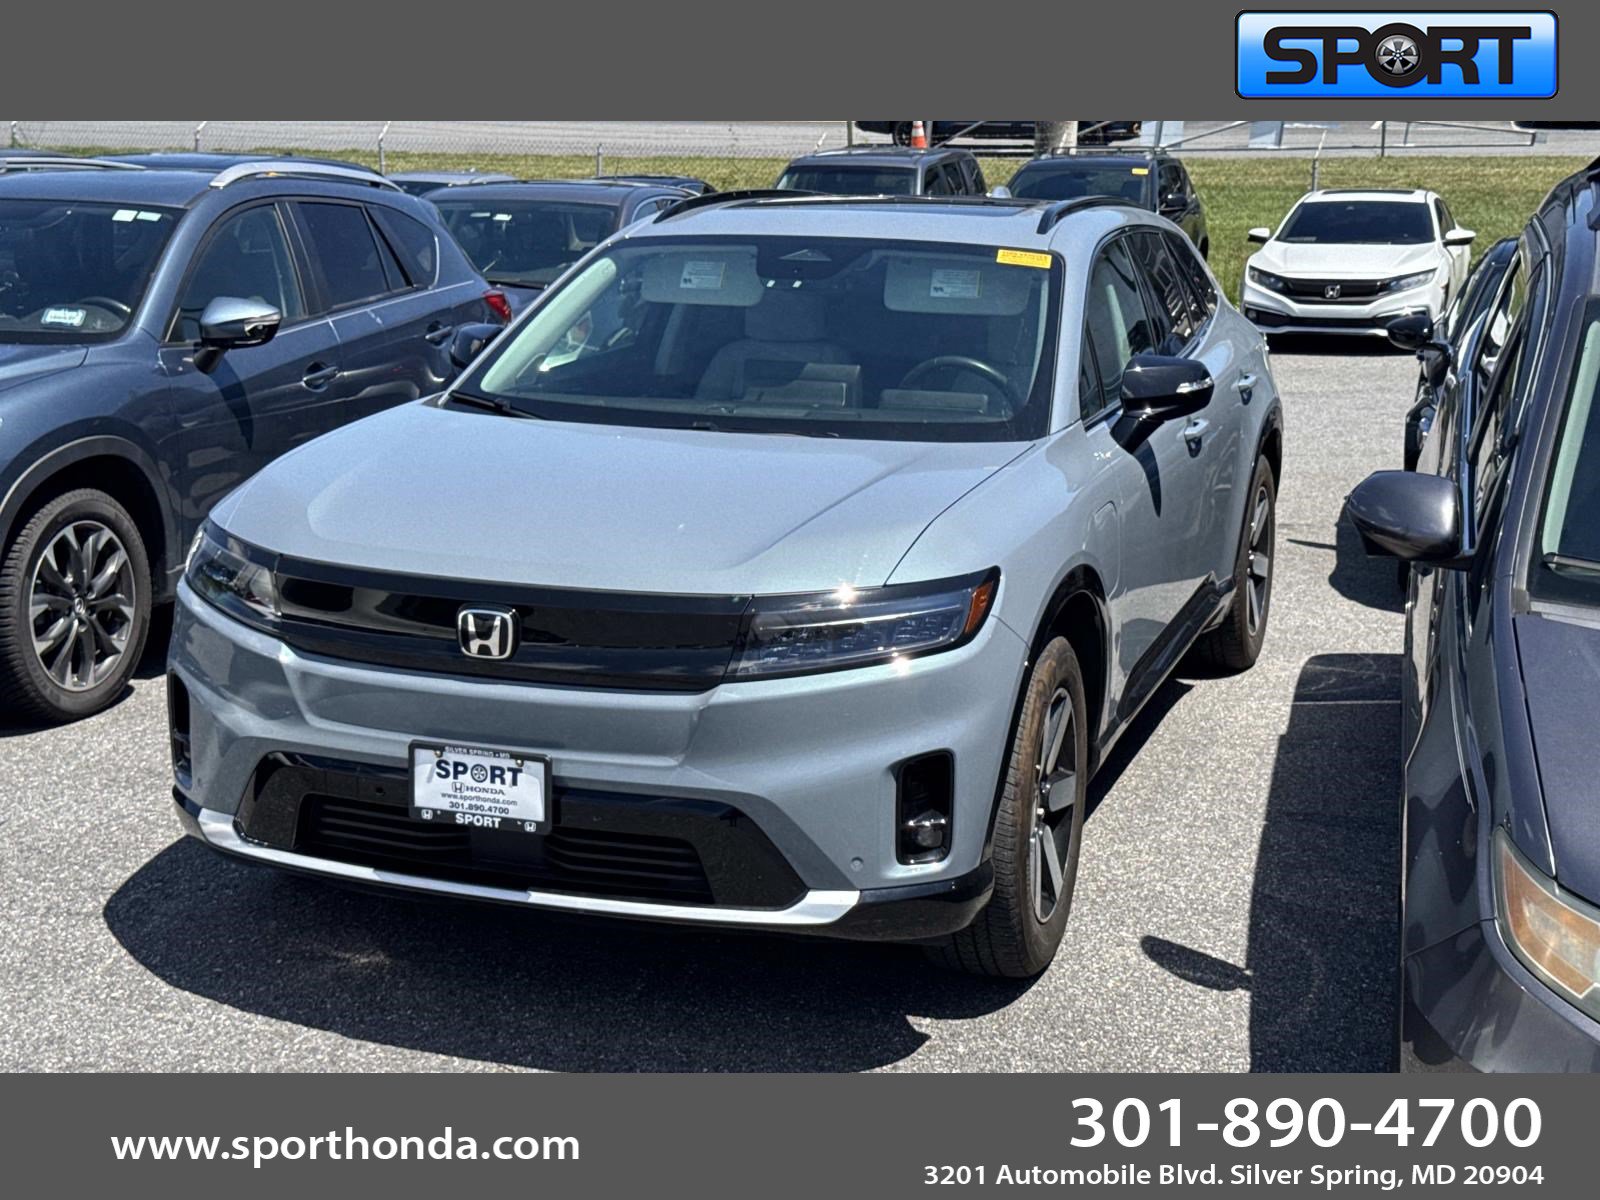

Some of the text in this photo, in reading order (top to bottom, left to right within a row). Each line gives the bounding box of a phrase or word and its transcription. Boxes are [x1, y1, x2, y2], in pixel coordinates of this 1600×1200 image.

[444, 746, 468, 755] SILVER
[468, 748, 494, 758] SPRING
[435, 759, 523, 786] SPORT
[465, 785, 506, 796] HONDA
[440, 792, 518, 806] www.sporthonda.com
[449, 801, 510, 815] 301.890.4700
[455, 813, 502, 828] SPORT
